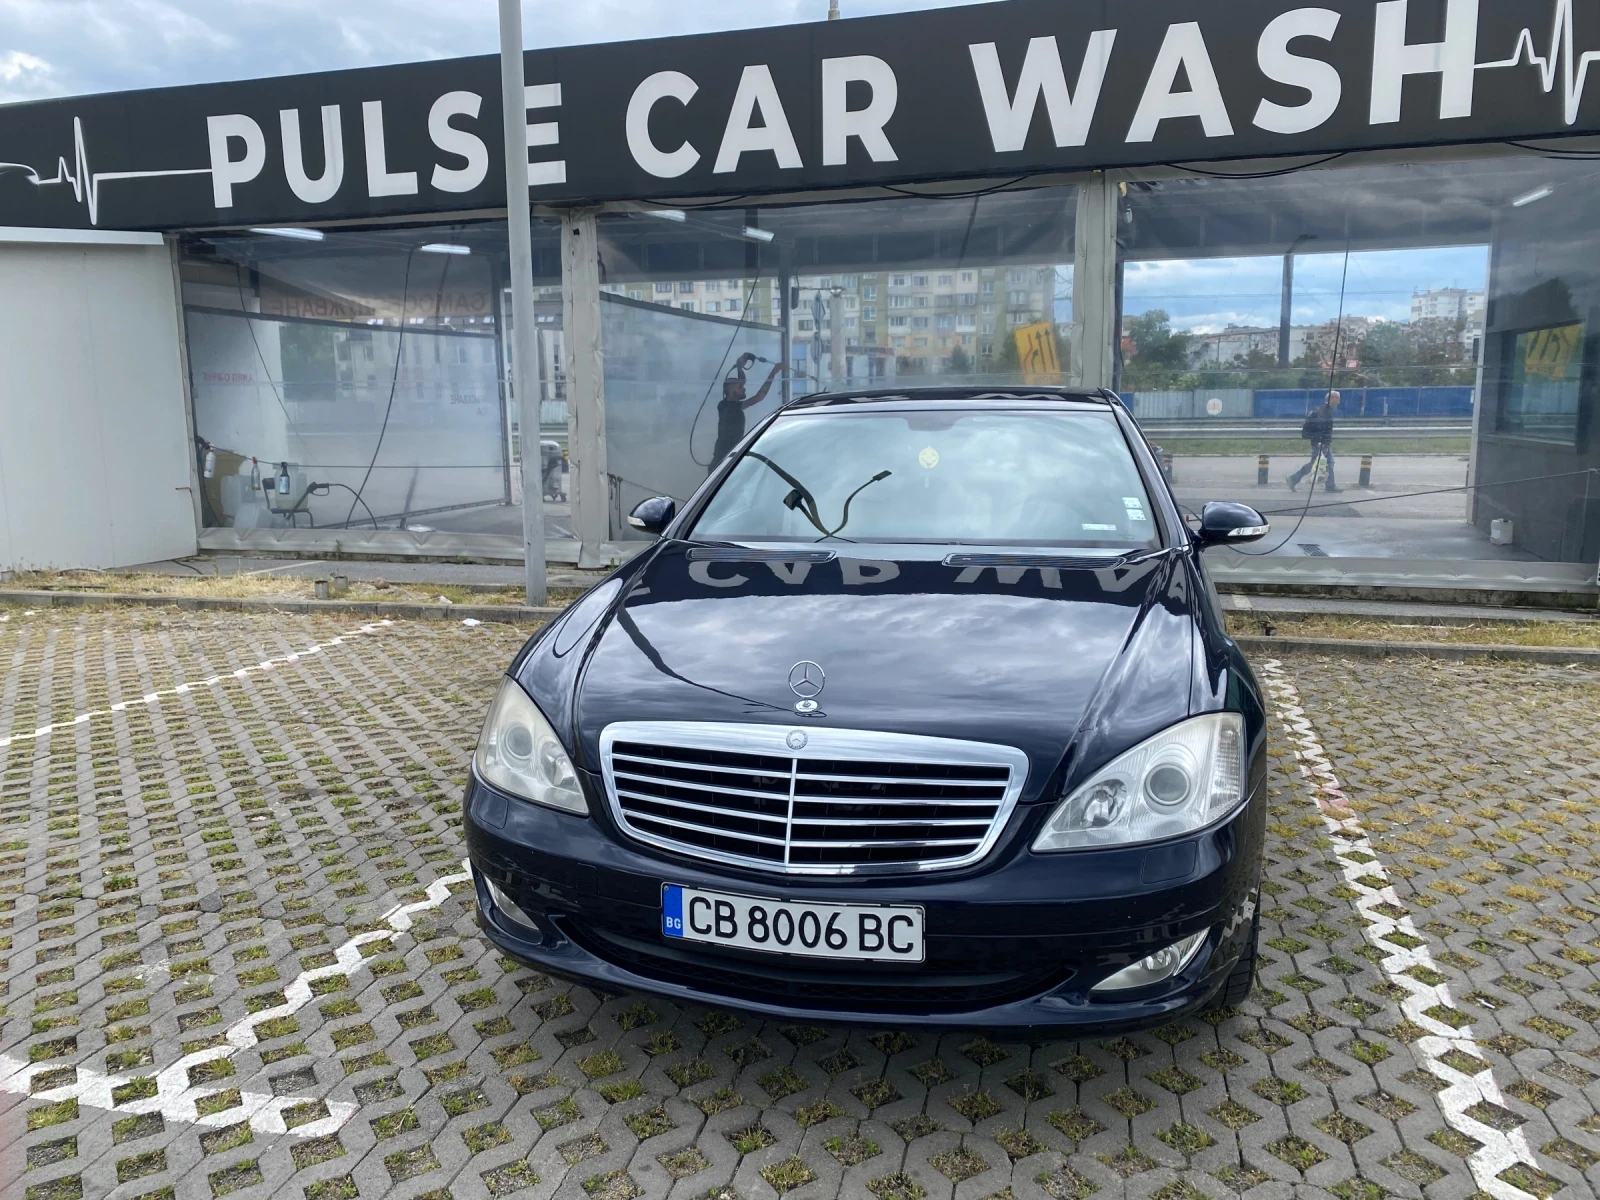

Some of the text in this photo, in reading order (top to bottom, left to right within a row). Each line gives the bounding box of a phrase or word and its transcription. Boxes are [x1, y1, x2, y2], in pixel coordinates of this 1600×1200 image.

[207, 0, 1480, 208] PULSE CAR WASH
[666, 916, 681, 930] BG
[689, 896, 914, 953] CB 8006 BC
